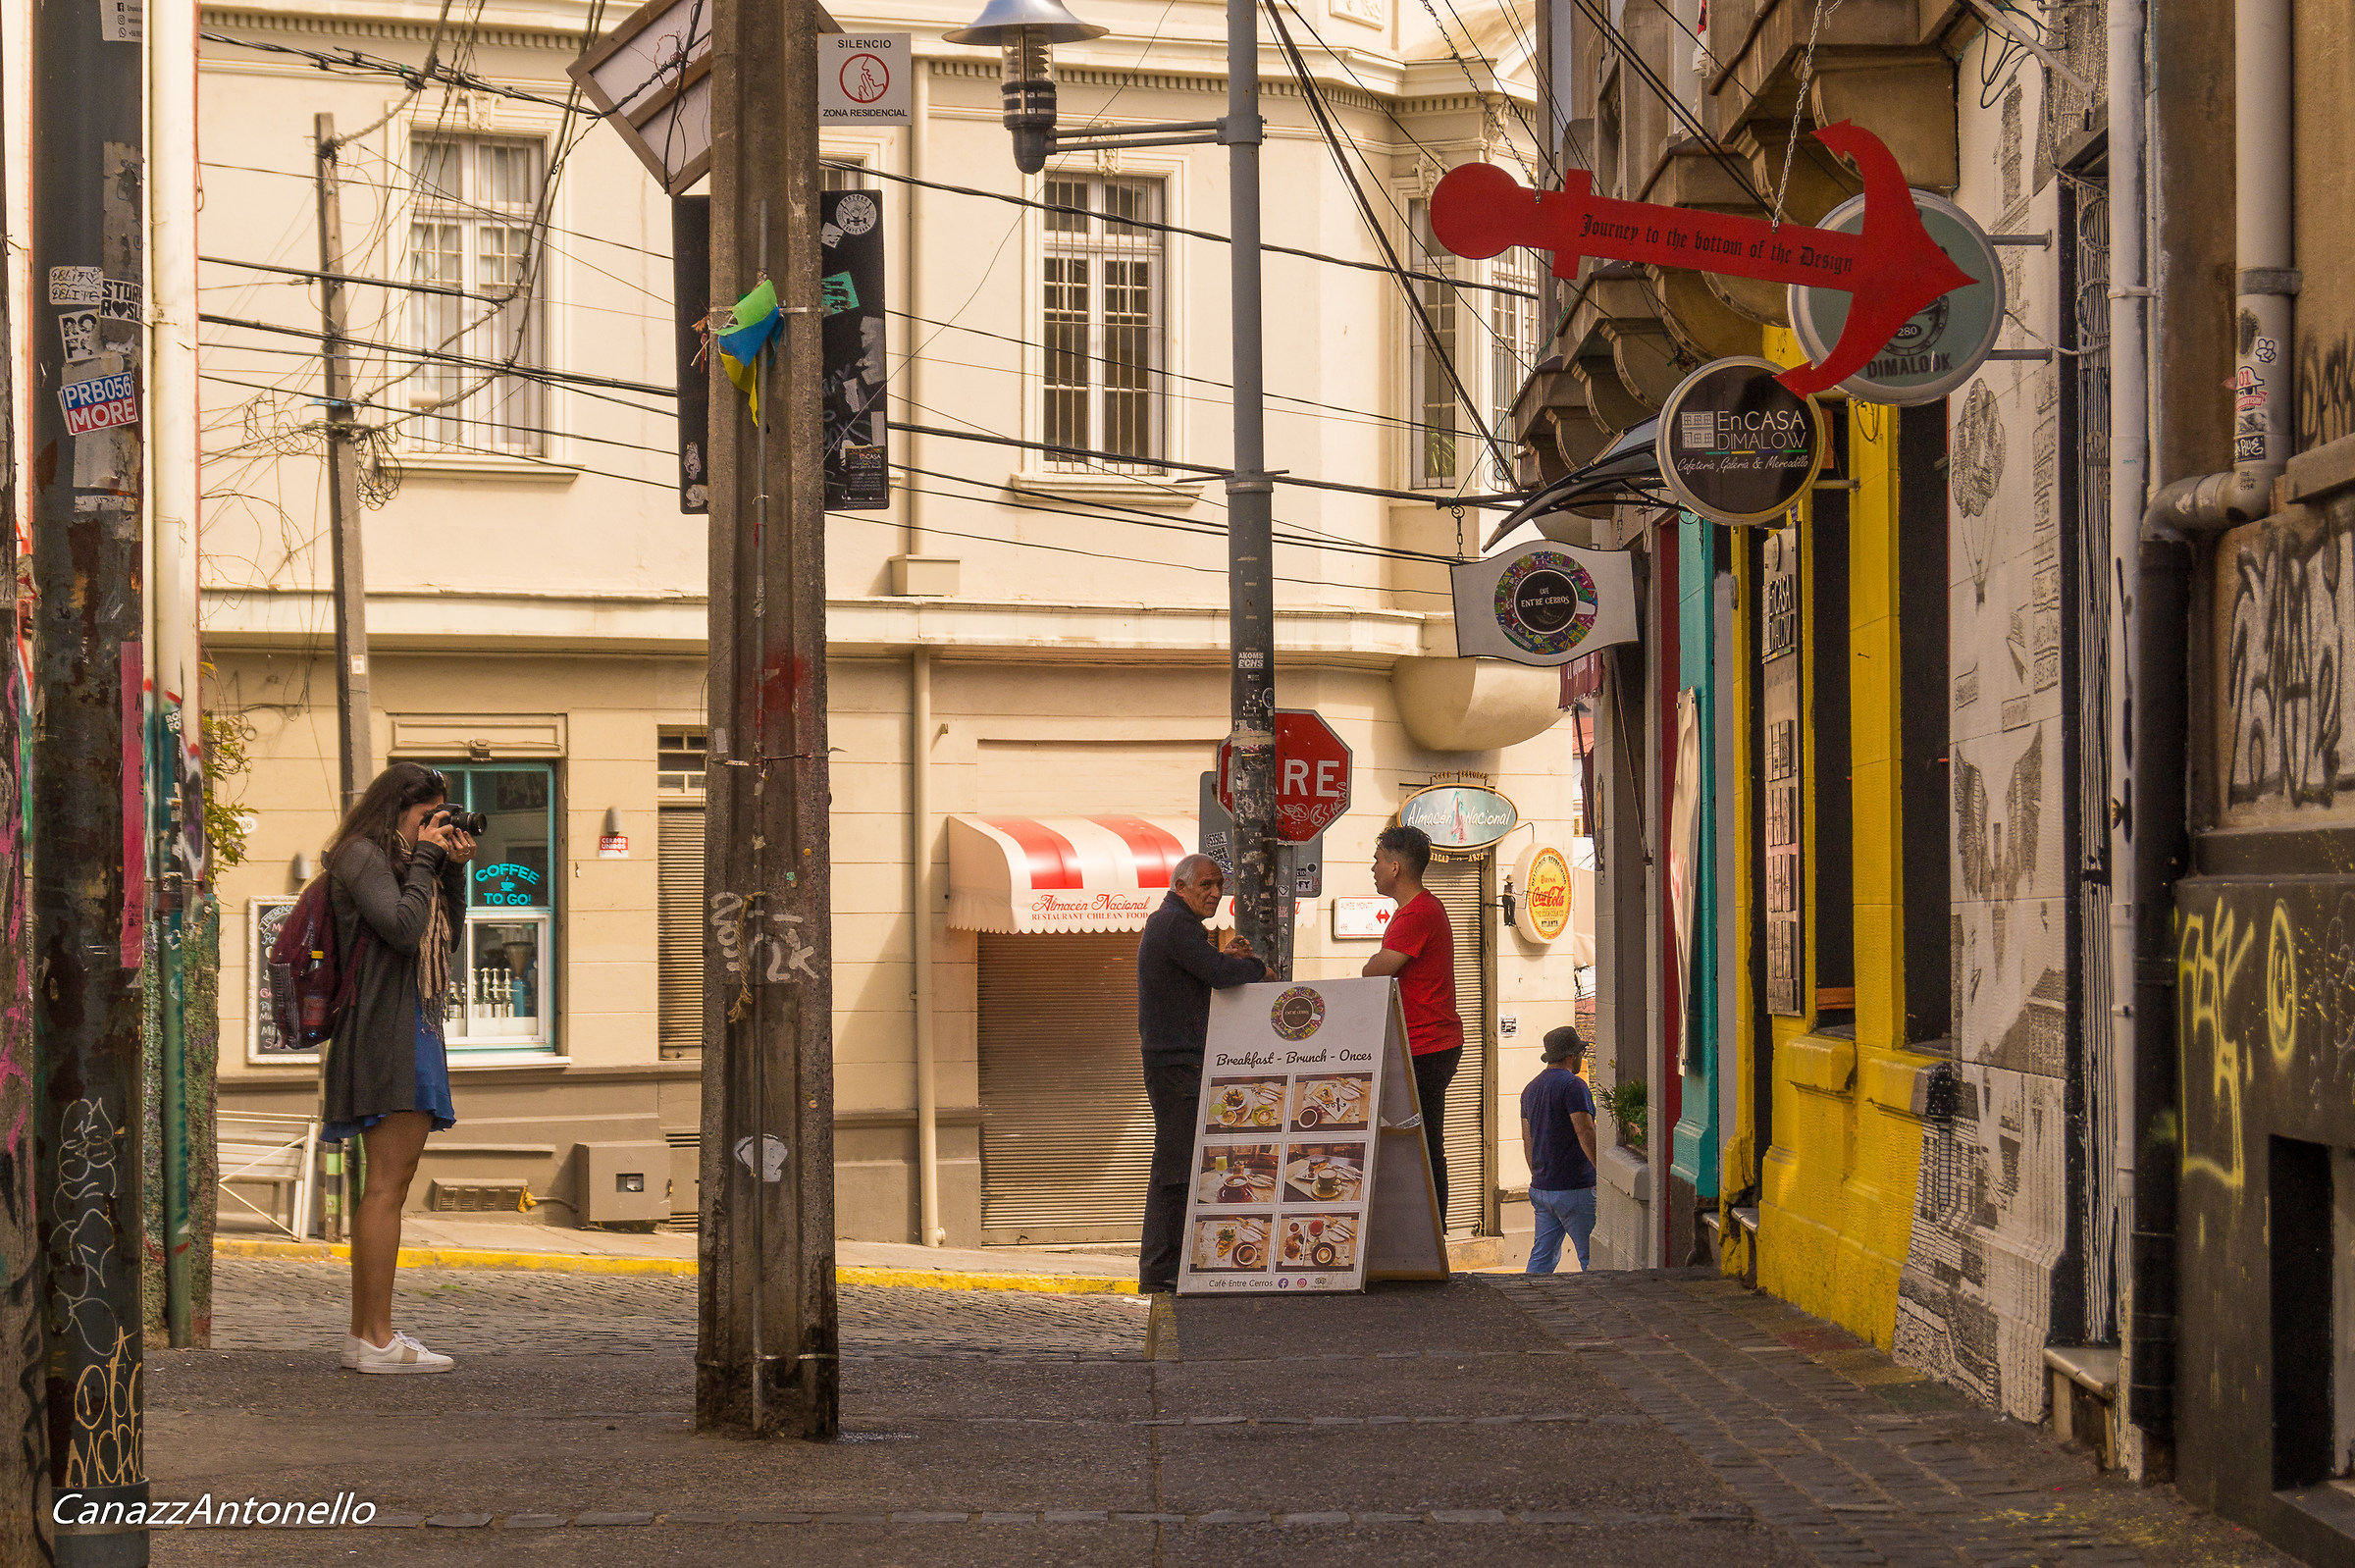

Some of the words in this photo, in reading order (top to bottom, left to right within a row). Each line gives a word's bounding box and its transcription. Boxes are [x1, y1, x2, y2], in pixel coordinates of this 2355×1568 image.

[838, 39, 892, 49] SILENCIO
[850, 108, 908, 117] RESIDENCIAL
[1579, 213, 1639, 245] Journey
[1646, 226, 1659, 244] to
[1667, 229, 1687, 249] the
[1695, 231, 1743, 257] bottom
[1750, 239, 1764, 258] of
[1770, 241, 1793, 265] the
[1799, 245, 1853, 276] Design
[2238, 370, 2251, 387] 01
[65, 376, 131, 408] PRB056
[70, 397, 135, 433] MORE
[1717, 432, 1806, 450] DIMALOW
[1752, 456, 1763, 469] &
[1764, 454, 1808, 469] Mercadillo
[1521, 598, 1544, 608] ENTRE
[1544, 596, 1570, 605] CERROS
[1407, 802, 1452, 826] Almacén
[1465, 806, 1512, 825] Nacional
[475, 862, 541, 885] COFFEE
[483, 892, 504, 905] TO
[506, 893, 532, 906] GO!
[1091, 893, 1150, 912] Nacional
[1216, 1052, 1275, 1070] Breakfast
[1285, 1048, 1328, 1065] Brunch
[1339, 1048, 1373, 1062] Onces
